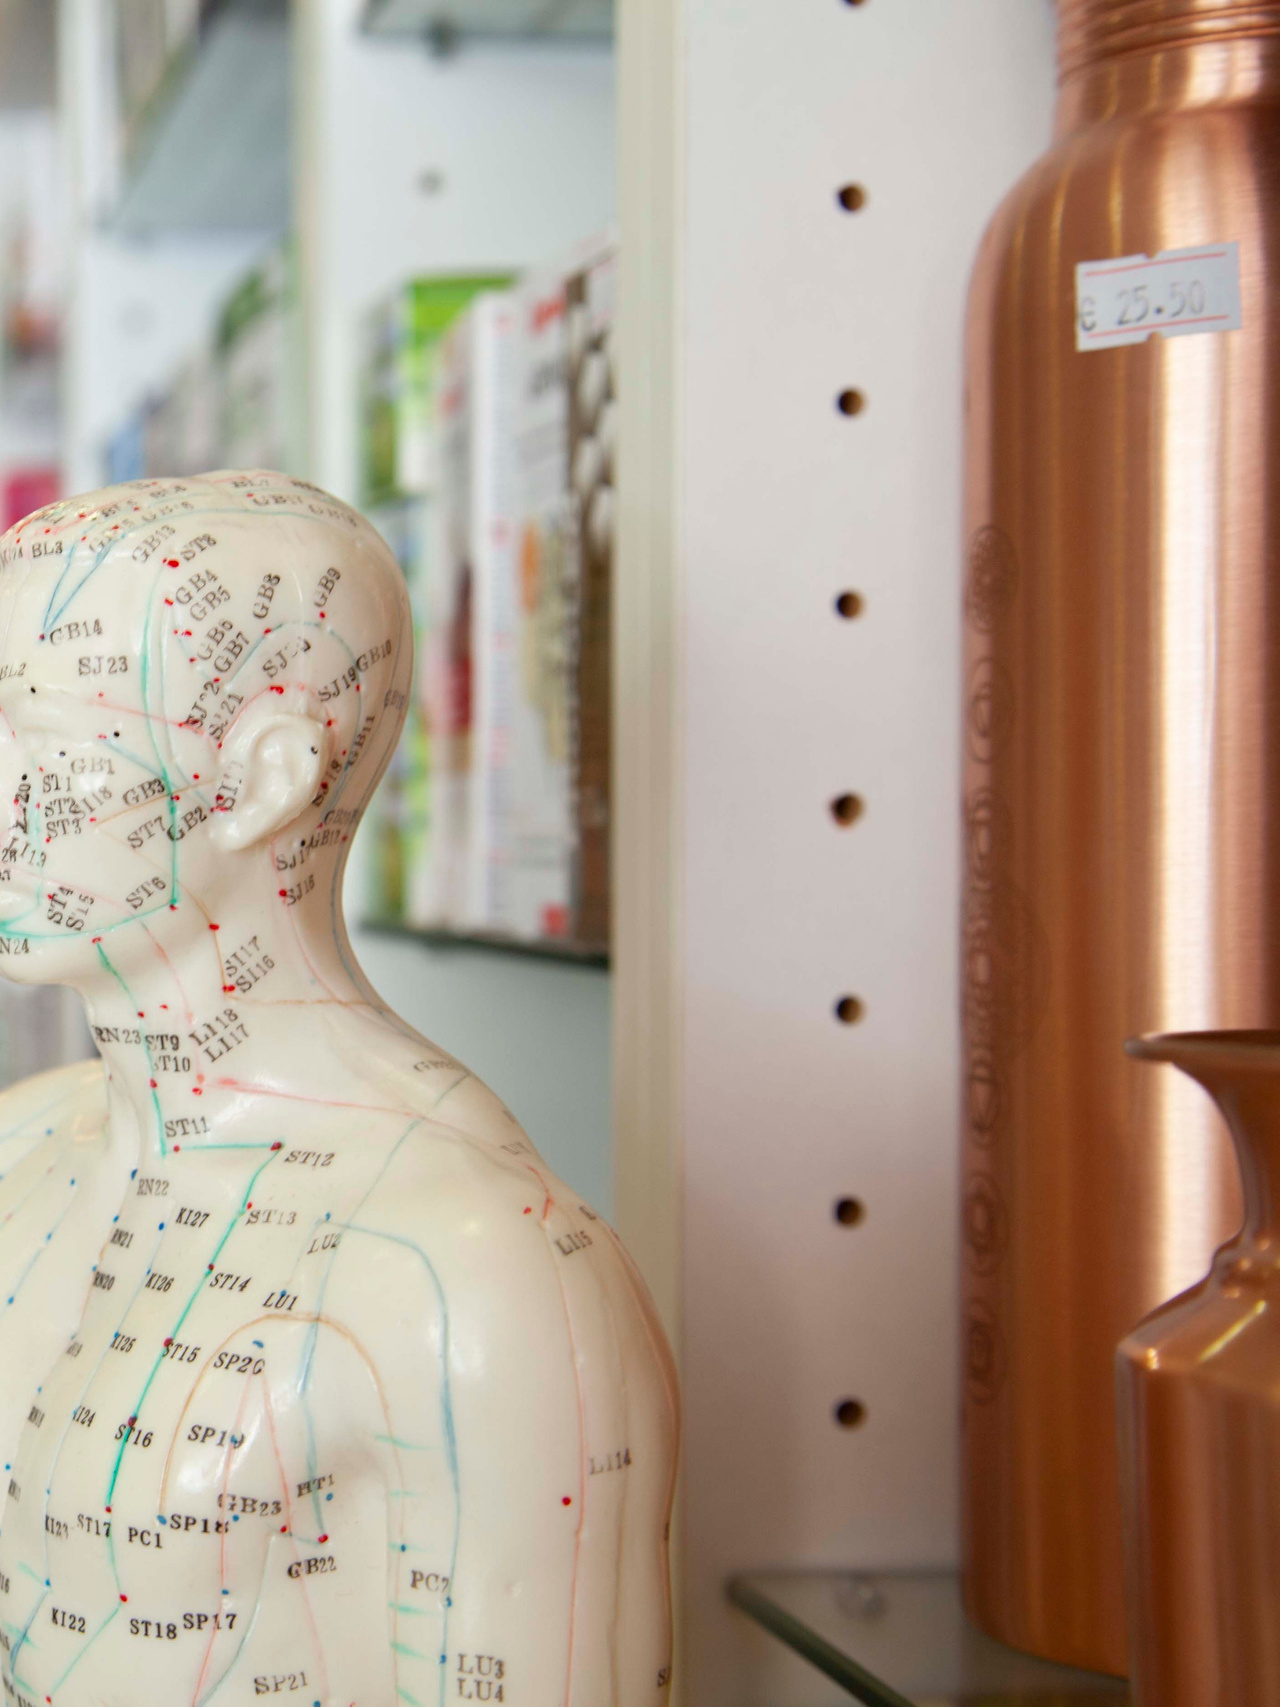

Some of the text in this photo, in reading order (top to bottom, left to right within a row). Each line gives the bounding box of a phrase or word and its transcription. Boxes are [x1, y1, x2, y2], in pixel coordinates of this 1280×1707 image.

[1080, 279, 1206, 332] € 25.50
[32, 540, 63, 558] BL3
[132, 524, 176, 563] GB13
[180, 532, 217, 562] ST8
[175, 568, 218, 606] GB4
[313, 567, 342, 609] GB9
[189, 584, 232, 622] GB5
[49, 618, 103, 645] GB14
[213, 631, 251, 673] GB7
[78, 655, 128, 676] SJ23
[318, 666, 357, 702] SJ19
[122, 777, 166, 806] GB3
[46, 818, 81, 839] ST3
[127, 815, 166, 850] ST7
[165, 805, 208, 842] GB2
[125, 876, 167, 910] ST6
[225, 935, 261, 978] SI17
[235, 954, 275, 994] SI16
[92, 1025, 142, 1045] RN23
[189, 1007, 240, 1047] LI18
[202, 1023, 250, 1063] LI17
[164, 1116, 211, 1138] ST11
[283, 1150, 336, 1168] ST12
[136, 1178, 170, 1197] RN22
[175, 1207, 210, 1228] KI27
[245, 1209, 298, 1226] ST13
[209, 1272, 253, 1293] ST14
[262, 1291, 299, 1311] LU1
[115, 1423, 154, 1448] ST16
[589, 1448, 632, 1475] LI14
[217, 1493, 282, 1517] GB23
[77, 1513, 113, 1538] ST17
[170, 1513, 229, 1535] SP18
[128, 1526, 163, 1549] PC1
[287, 1555, 337, 1579] GB22
[51, 1607, 87, 1634] KI22
[129, 1618, 178, 1640] ST18
[183, 1612, 237, 1631] SP17
[458, 1653, 506, 1680] LU3
[254, 1671, 308, 1695] SP21
[458, 1678, 506, 1703] LU4
